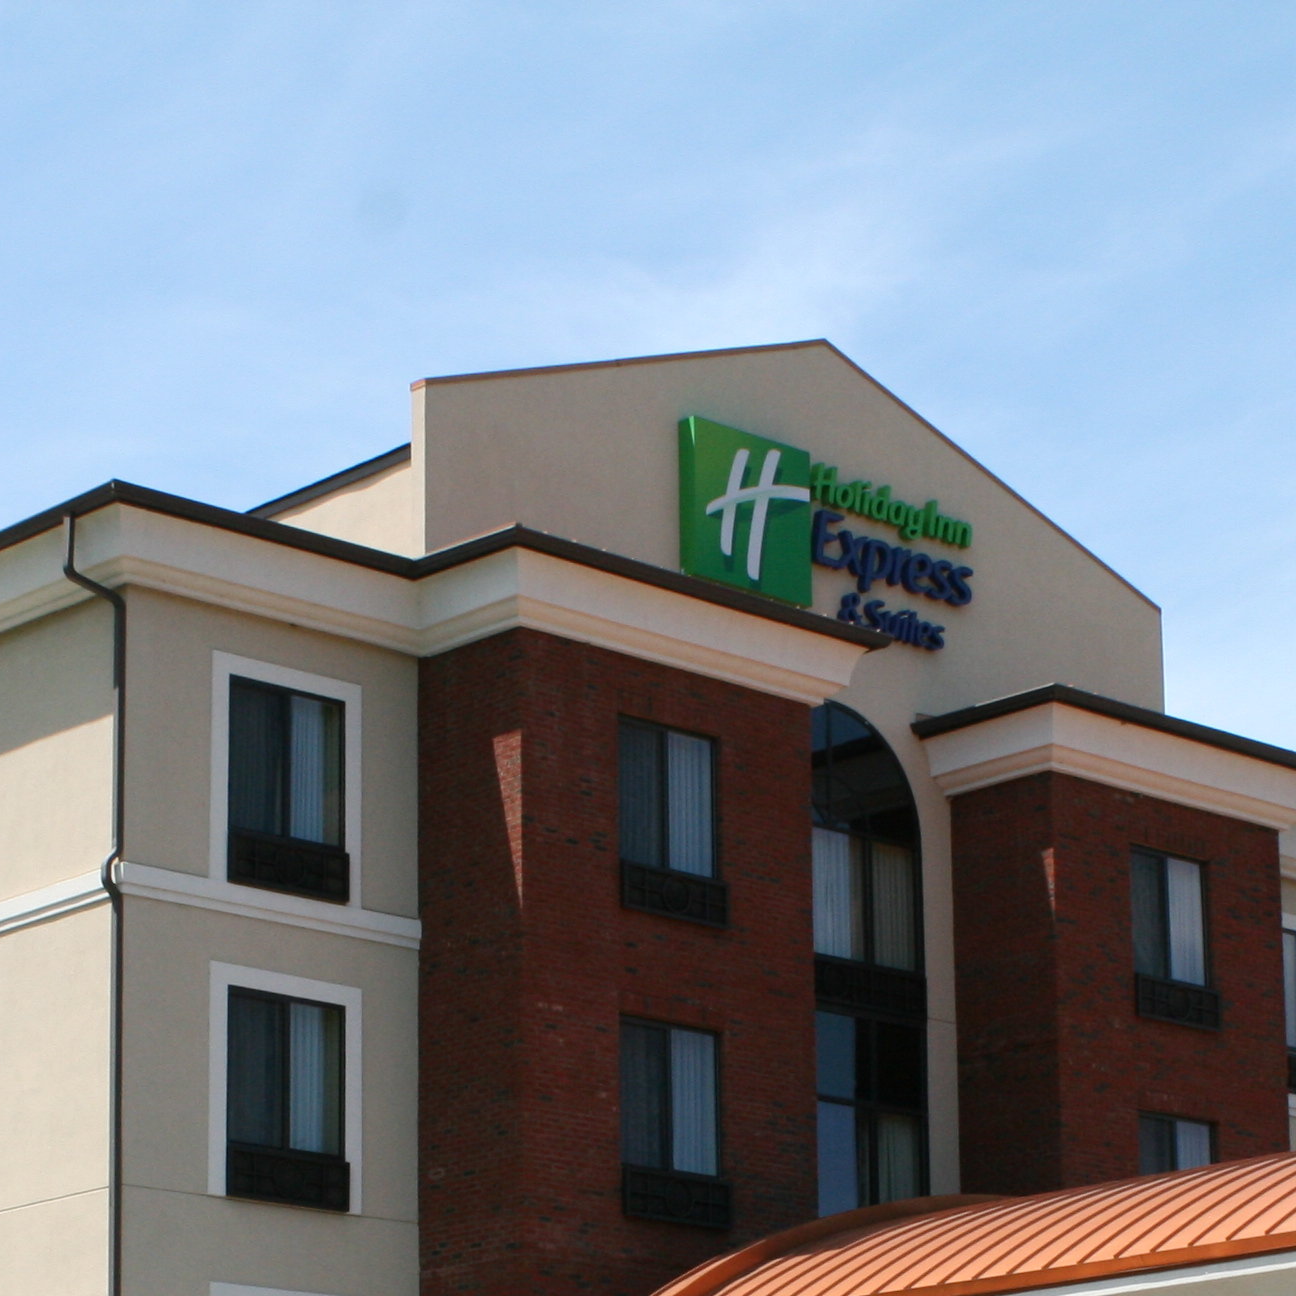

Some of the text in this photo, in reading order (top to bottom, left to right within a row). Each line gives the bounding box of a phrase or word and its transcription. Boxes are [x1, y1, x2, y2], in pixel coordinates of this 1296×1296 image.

[811, 462, 973, 549] Holiday Inn
[812, 509, 974, 607] Express
[837, 592, 946, 651] & Suites
